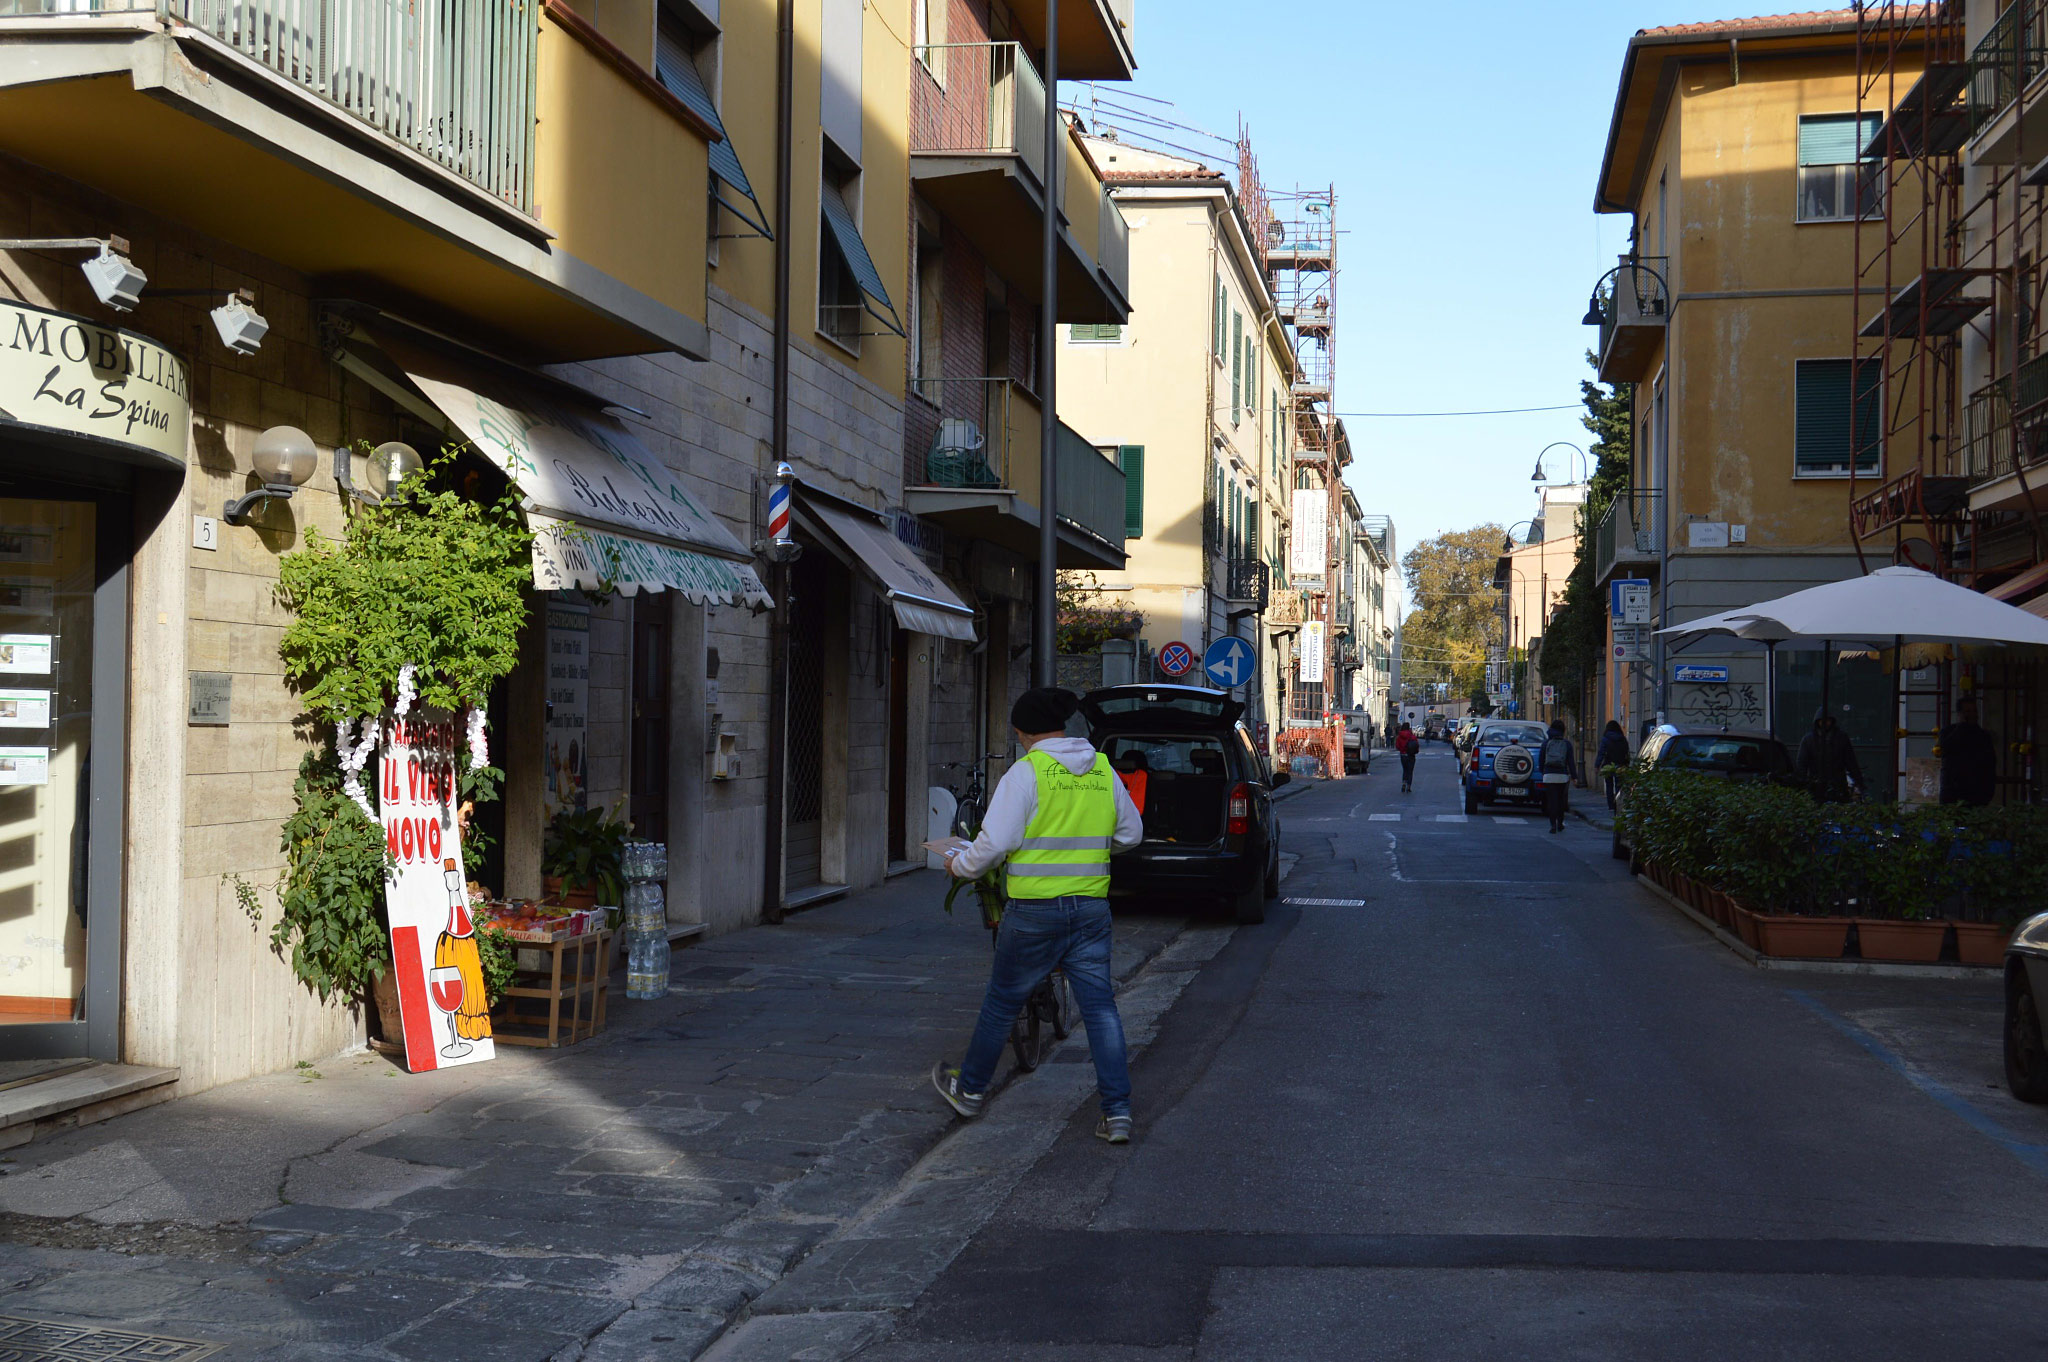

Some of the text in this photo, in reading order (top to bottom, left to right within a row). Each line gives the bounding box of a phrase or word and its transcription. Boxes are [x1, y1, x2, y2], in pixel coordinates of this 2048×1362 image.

[33, 364, 170, 436] La Spina
[203, 522, 211, 542] 5
[559, 549, 588, 572] VINI
[546, 611, 588, 630] GASTRONOMIA
[383, 757, 454, 808] IL VINO
[386, 815, 443, 865] NOVO
